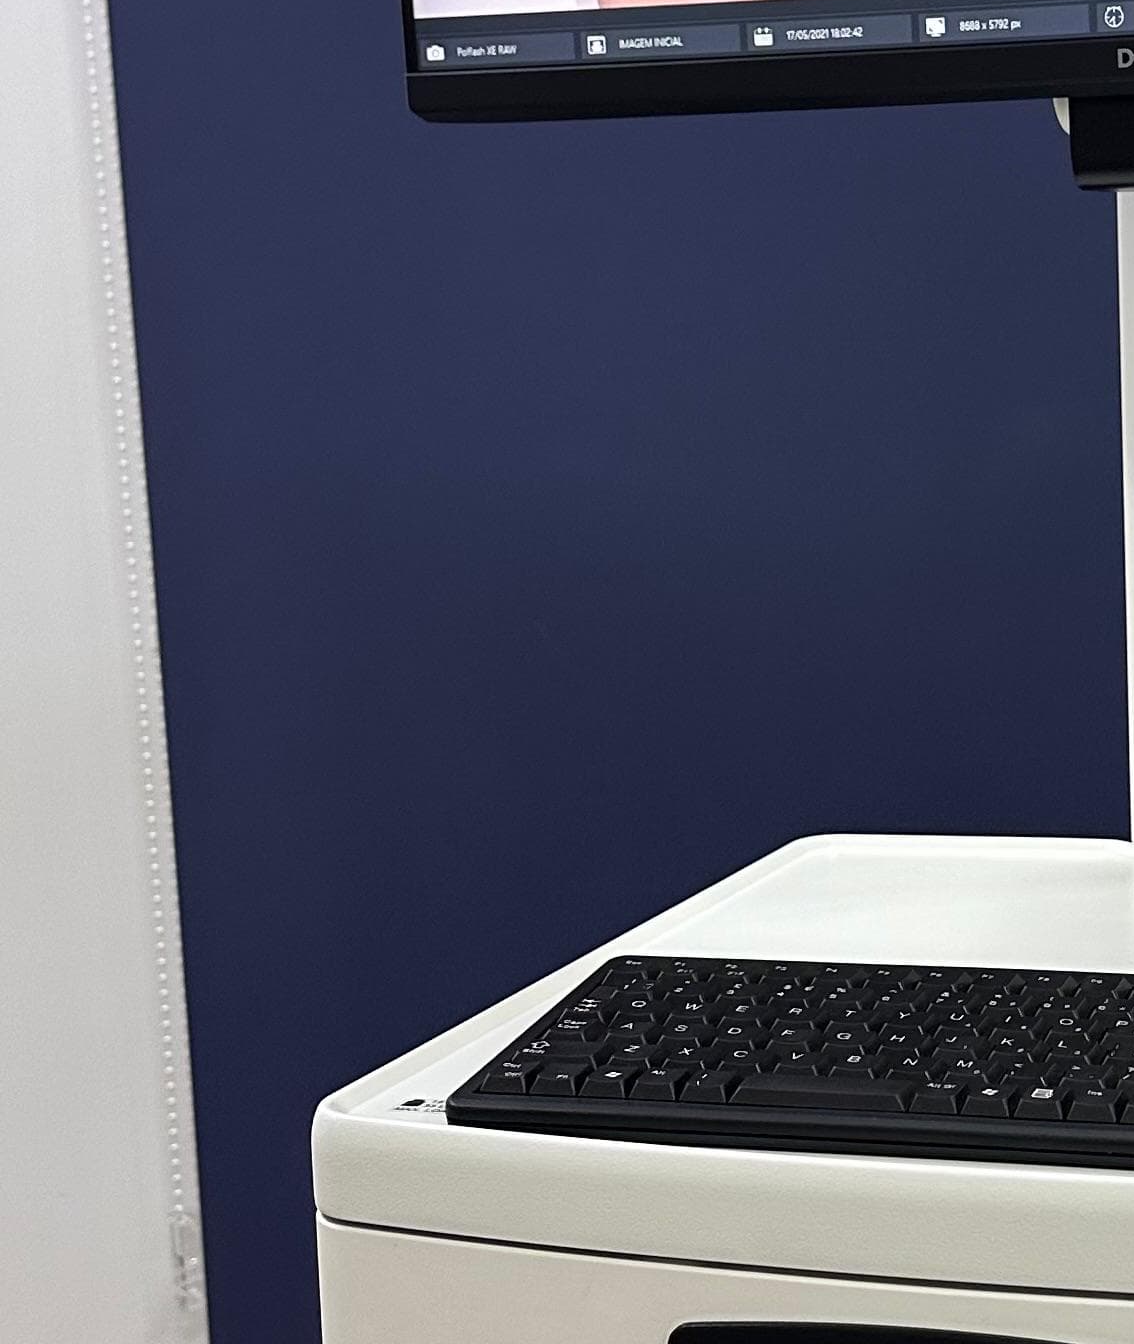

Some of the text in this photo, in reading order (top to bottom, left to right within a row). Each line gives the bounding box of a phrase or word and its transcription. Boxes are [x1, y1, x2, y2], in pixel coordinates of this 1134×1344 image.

[988, 19, 1009, 30] 5792
[1010, 20, 1021, 31] px
[618, 37, 653, 49] IMAGEM
[735, 1005, 750, 1013] E
[788, 1007, 803, 1015] R
[845, 1009, 857, 1017] T
[899, 1011, 911, 1019] Y
[950, 1012, 965, 1021] U
[620, 1022, 634, 1030] A
[1059, 1018, 1074, 1026] O
[1115, 1020, 1129, 1028] P
[674, 1024, 689, 1032] S
[727, 1027, 742, 1035] D
[780, 1028, 796, 1037] F
[836, 1032, 852, 1040] G
[889, 1034, 906, 1043] H
[945, 1035, 957, 1044] J
[1000, 1037, 1015, 1046] K
[1057, 1039, 1068, 1049] L
[624, 1044, 640, 1053] Z
[678, 1047, 694, 1056] X
[733, 1050, 749, 1058] C
[792, 1052, 805, 1060] V
[846, 1055, 862, 1063] B
[902, 1057, 919, 1066] N
[956, 1059, 974, 1069] M
